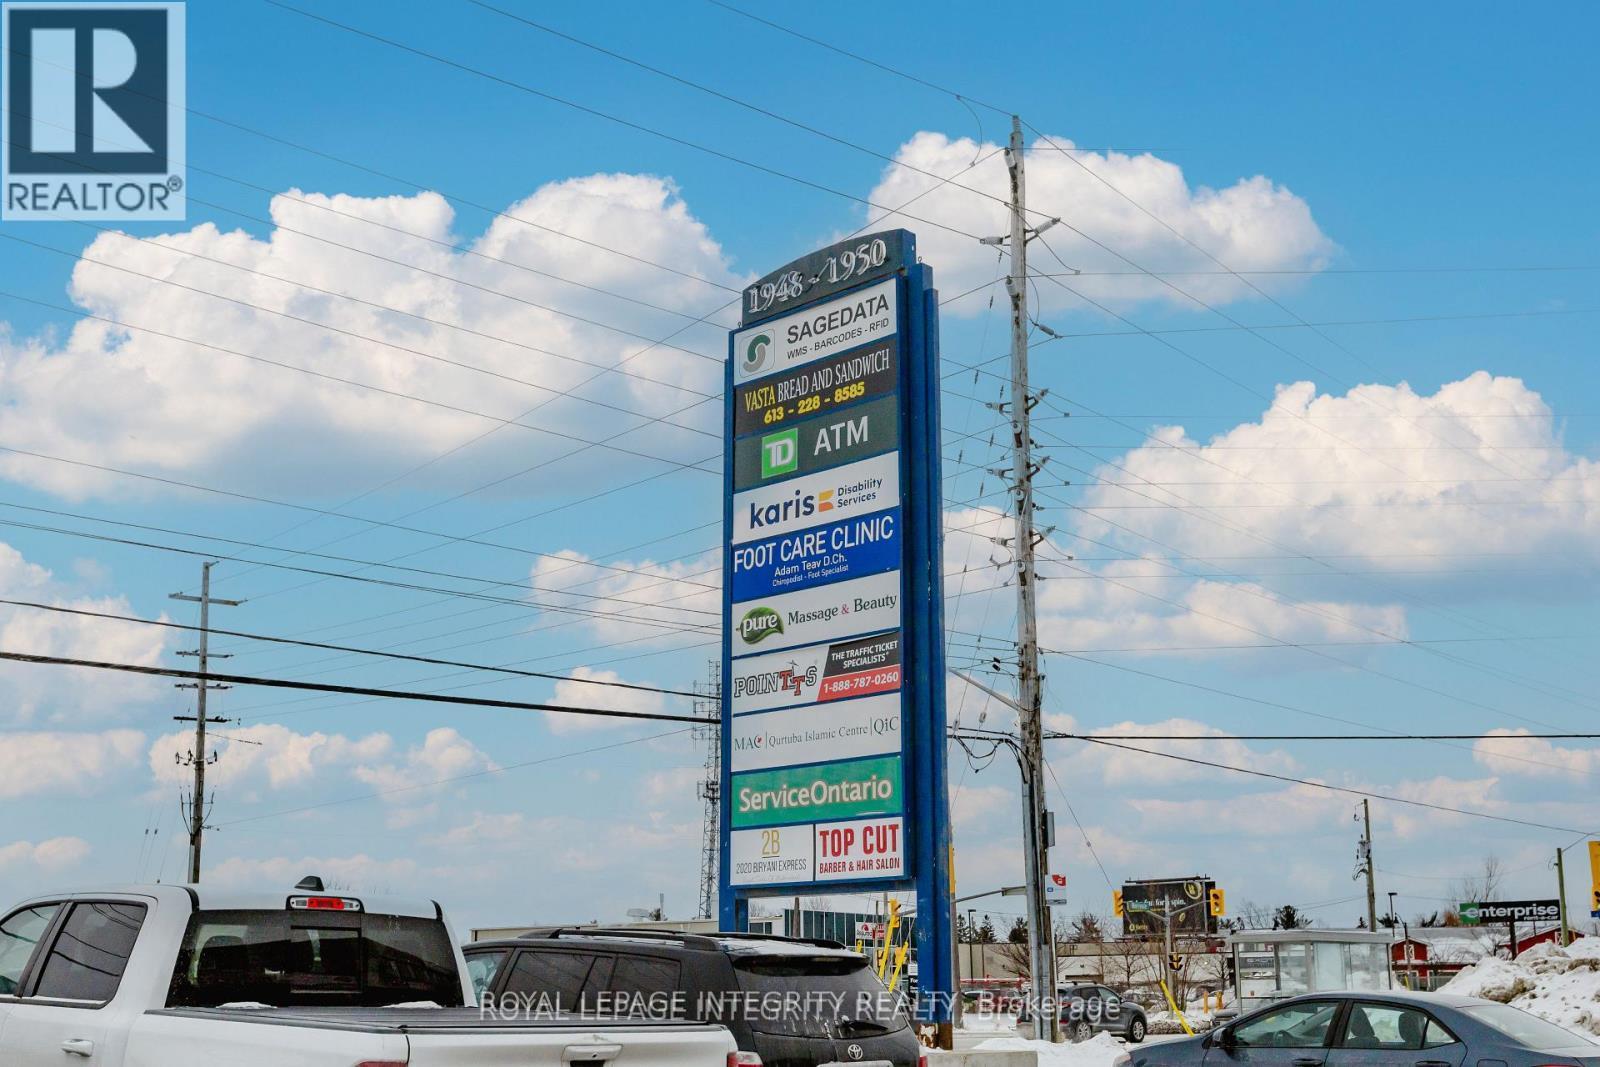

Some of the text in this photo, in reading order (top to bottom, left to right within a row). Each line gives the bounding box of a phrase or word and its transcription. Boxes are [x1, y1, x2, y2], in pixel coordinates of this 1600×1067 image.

[748, 270, 803, 313] 1948
[820, 238, 887, 283] 1950
[787, 293, 889, 344] SAGEDATA
[786, 345, 808, 359] WMS
[814, 327, 862, 352] BARCODES
[869, 317, 889, 333] RFID
[745, 348, 890, 412] VASTA BREAD AND SANDWICH
[763, 406, 784, 424] 613
[797, 394, 821, 414] 228
[834, 381, 865, 403] 8585
[814, 415, 868, 456] ATM
[765, 438, 795, 468] TD
[837, 477, 883, 497] Disability
[837, 492, 876, 508] Services
[750, 489, 815, 529] karis
[734, 515, 893, 573] FOOT CARE CLINIC
[772, 574, 803, 587] Chiropodist
[808, 570, 820, 580] Foot
[821, 564, 849, 578] Specialist
[774, 552, 848, 577] Adam Teav D.Ch.
[742, 612, 778, 638] pure
[788, 594, 897, 626] Massage & Beauty
[831, 640, 898, 661] THE TRAFFIC TICKET
[823, 671, 899, 694] 1-888-787-0260
[768, 733, 802, 748] Qurtuba
[805, 726, 836, 743] Islamic
[838, 724, 868, 738] Centre
[873, 716, 899, 735] QiC
[739, 775, 892, 812] ServiceOntario
[761, 829, 780, 855] 2B
[819, 823, 899, 858] TOP CUT
[736, 858, 807, 875] 2020 BIRYANI EXPRESS
[819, 857, 900, 874] BARBER & HAIR SALON
[1460, 903, 1558, 919] enterprise
